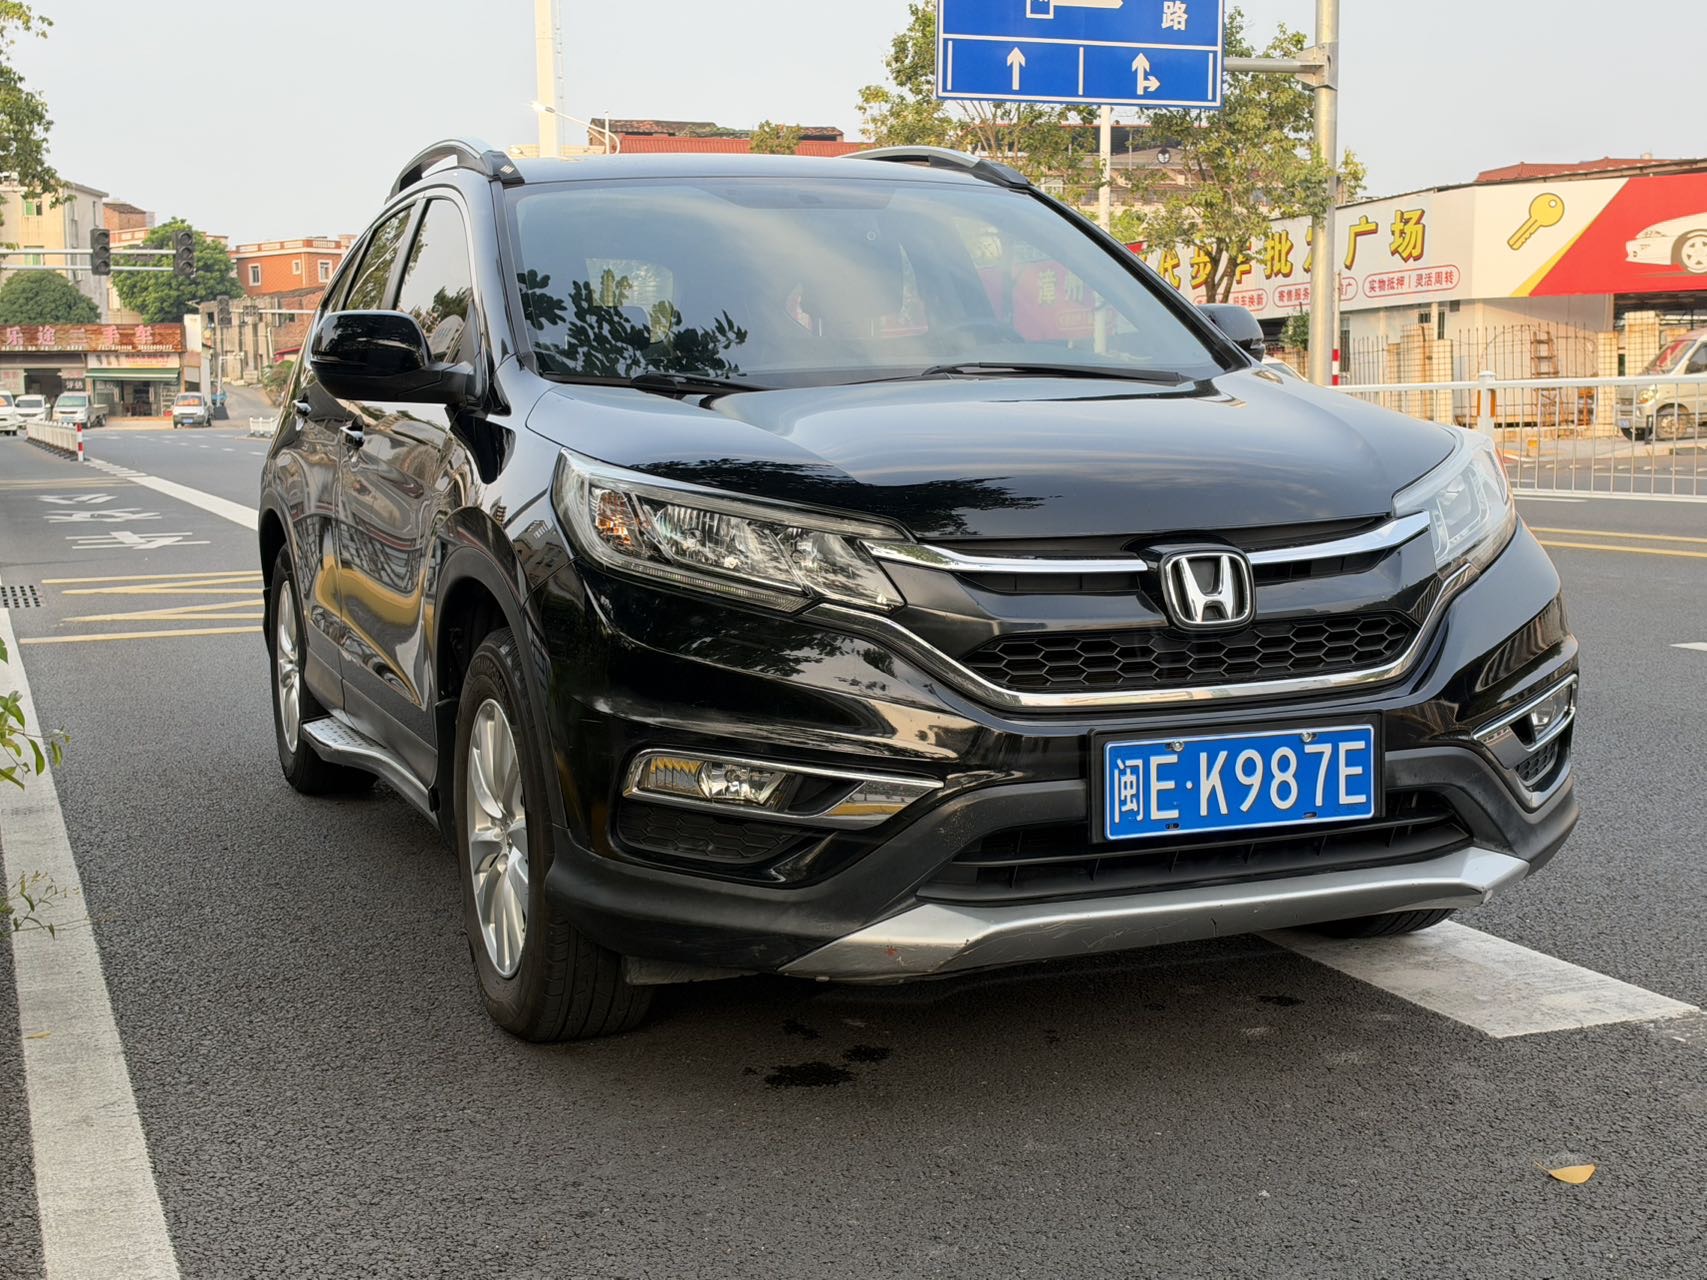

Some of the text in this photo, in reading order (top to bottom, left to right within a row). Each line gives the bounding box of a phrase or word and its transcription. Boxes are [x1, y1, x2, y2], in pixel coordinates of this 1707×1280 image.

[1161, 0, 1188, 31] 路
[1368, 269, 1455, 293] 实物抵押 灵活周转
